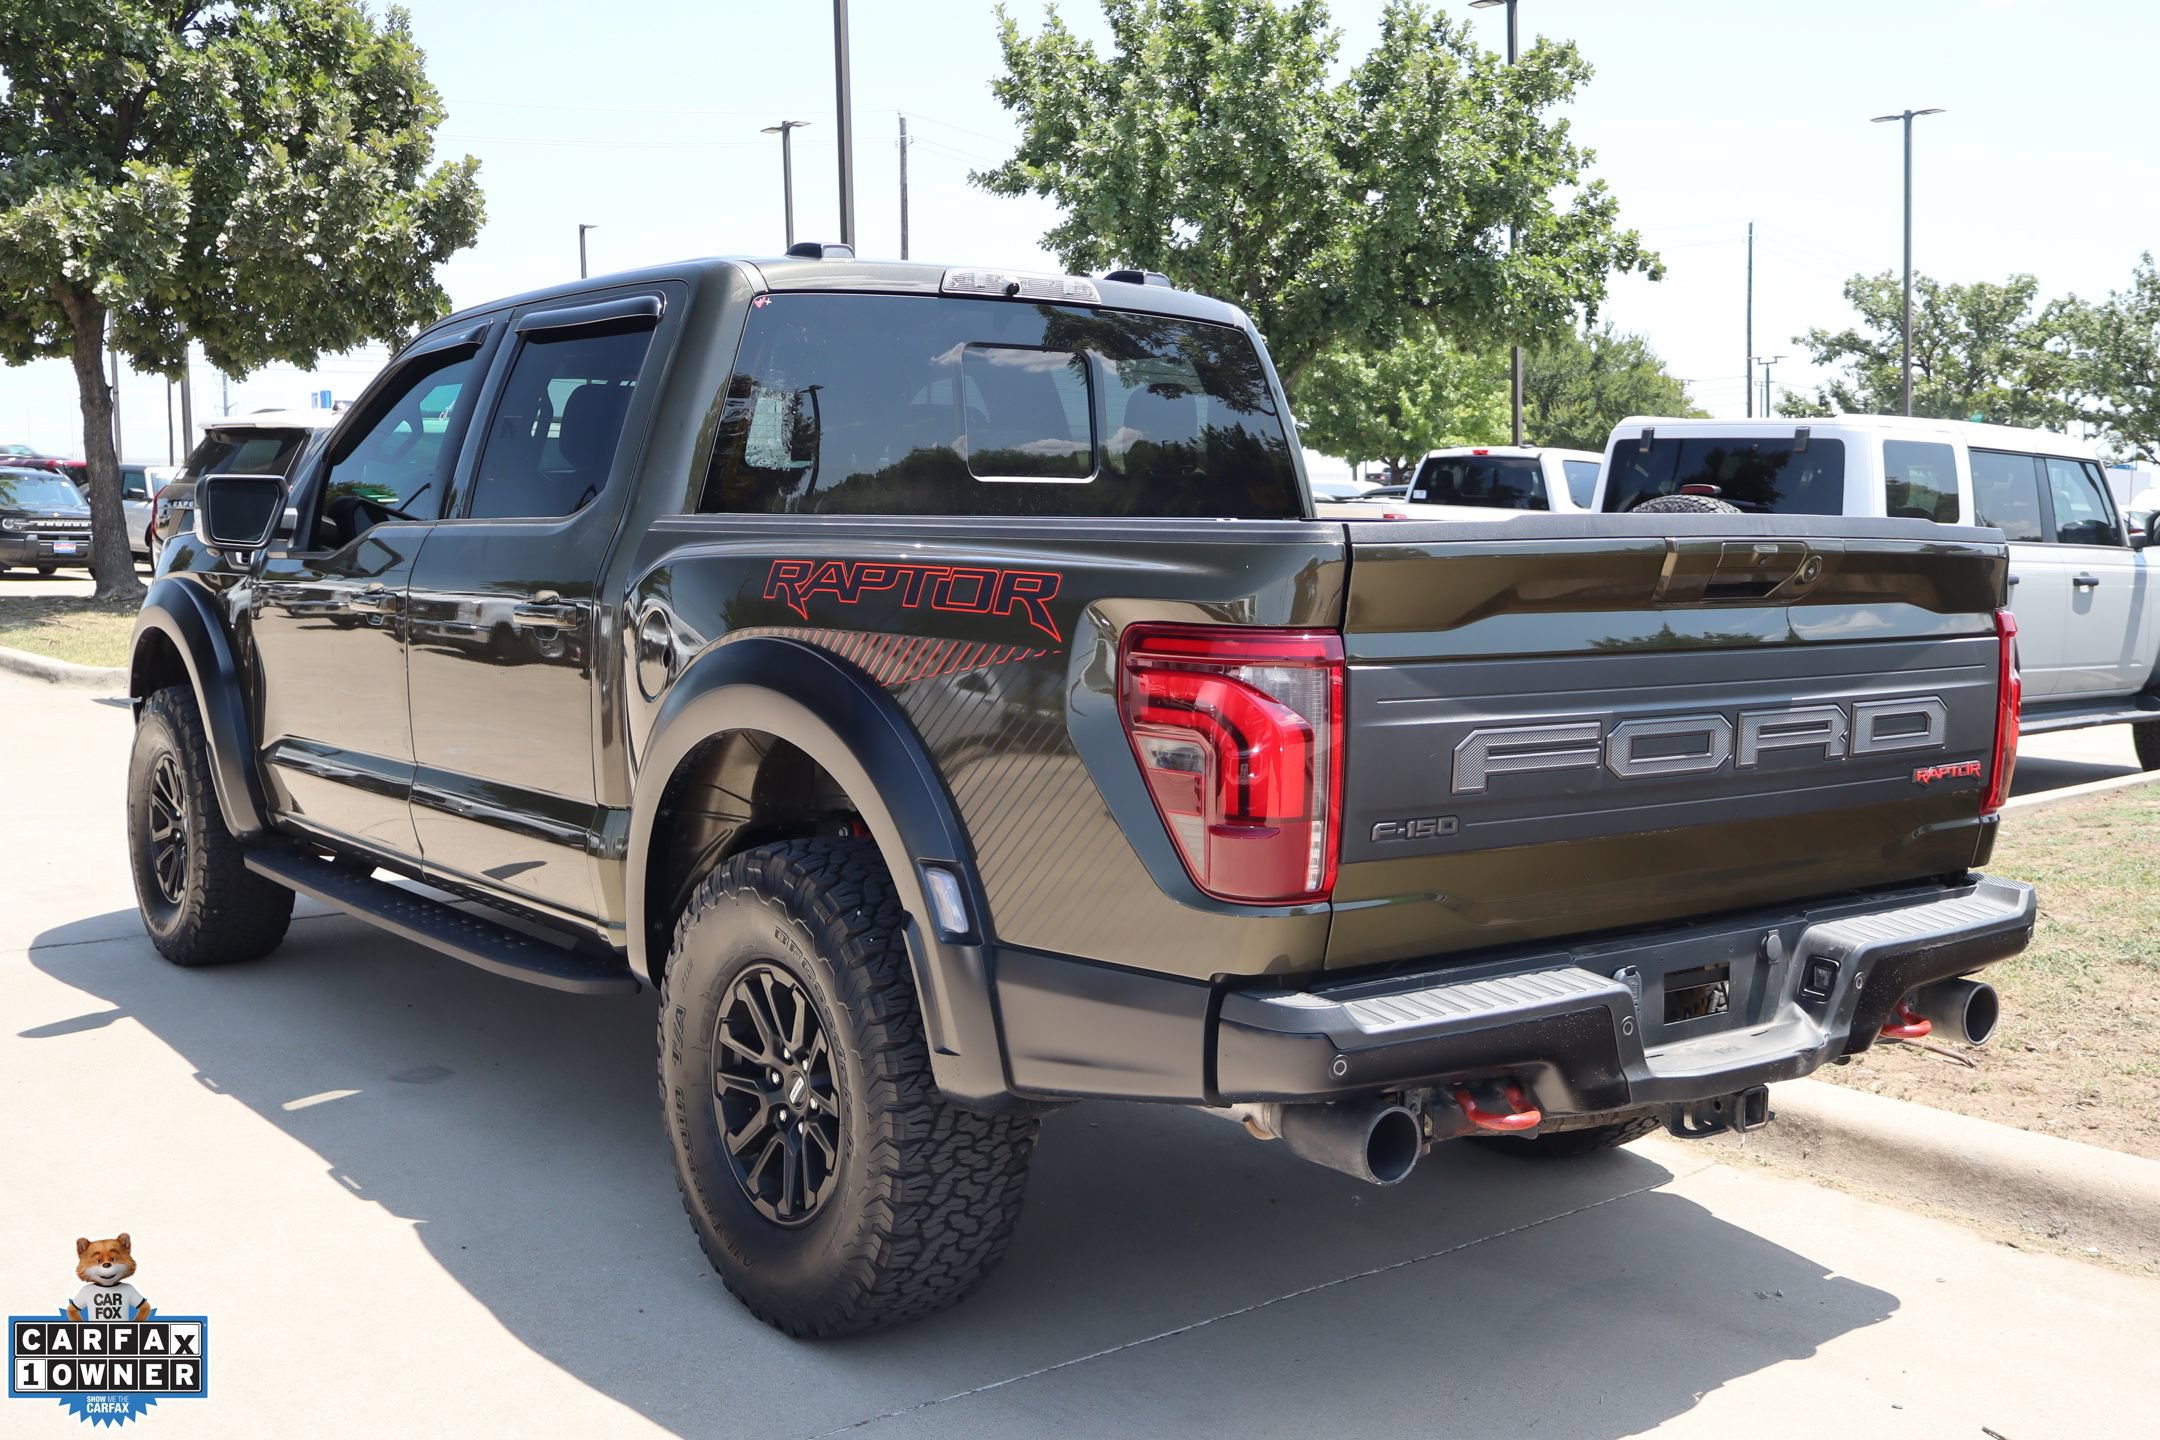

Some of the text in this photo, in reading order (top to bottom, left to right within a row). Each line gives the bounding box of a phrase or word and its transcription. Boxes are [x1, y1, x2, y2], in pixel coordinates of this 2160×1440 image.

[763, 559, 1063, 643] RAPTOR
[1451, 696, 1949, 796] FORD
[1913, 759, 1981, 785] RAPTOR
[1370, 815, 1460, 842] F-150
[671, 1003, 687, 1067] T/A
